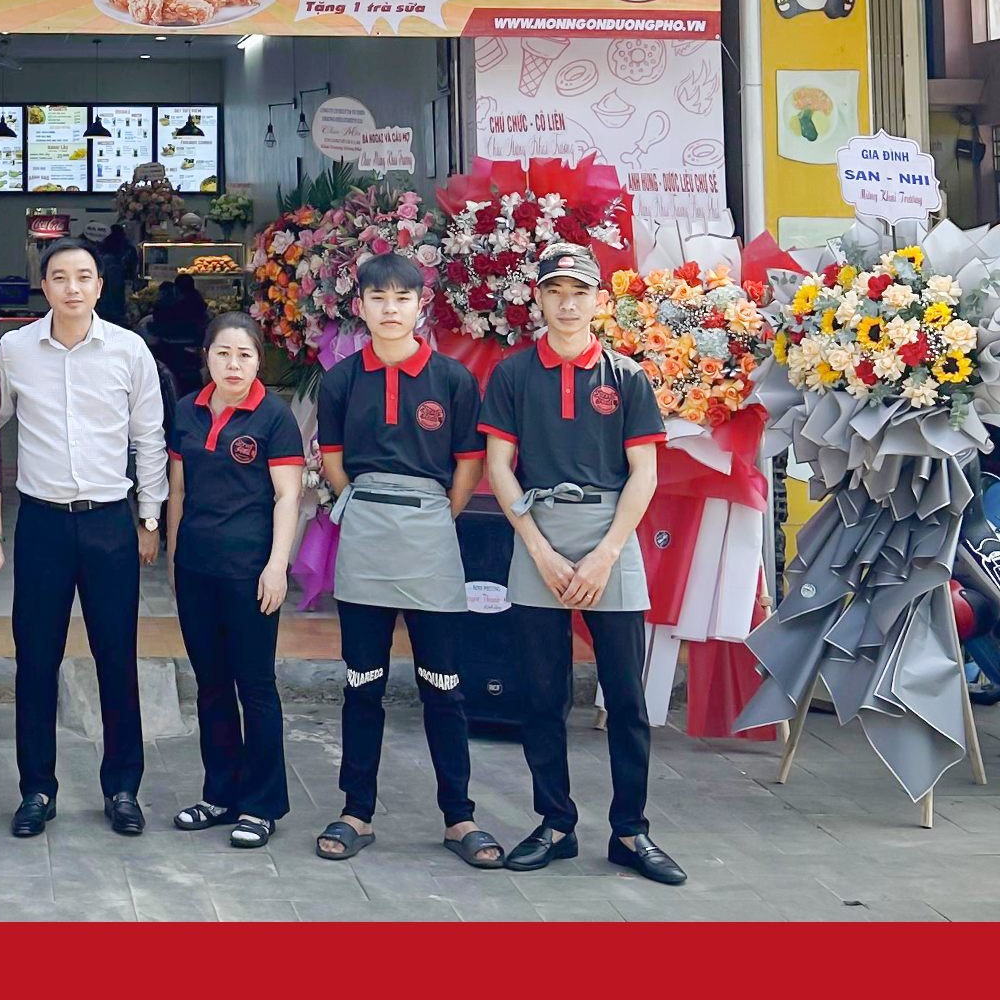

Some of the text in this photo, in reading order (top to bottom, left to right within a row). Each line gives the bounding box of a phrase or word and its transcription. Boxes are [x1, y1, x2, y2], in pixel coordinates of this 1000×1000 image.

[305, 1, 426, 15] Tặng 1 trà sữa
[494, 17, 707, 33] WWW.MONNGONDUONGPHO.VN
[861, 148, 910, 162] GIA ĐÌNH
[844, 169, 881, 182] SAN
[899, 172, 930, 186] NHI
